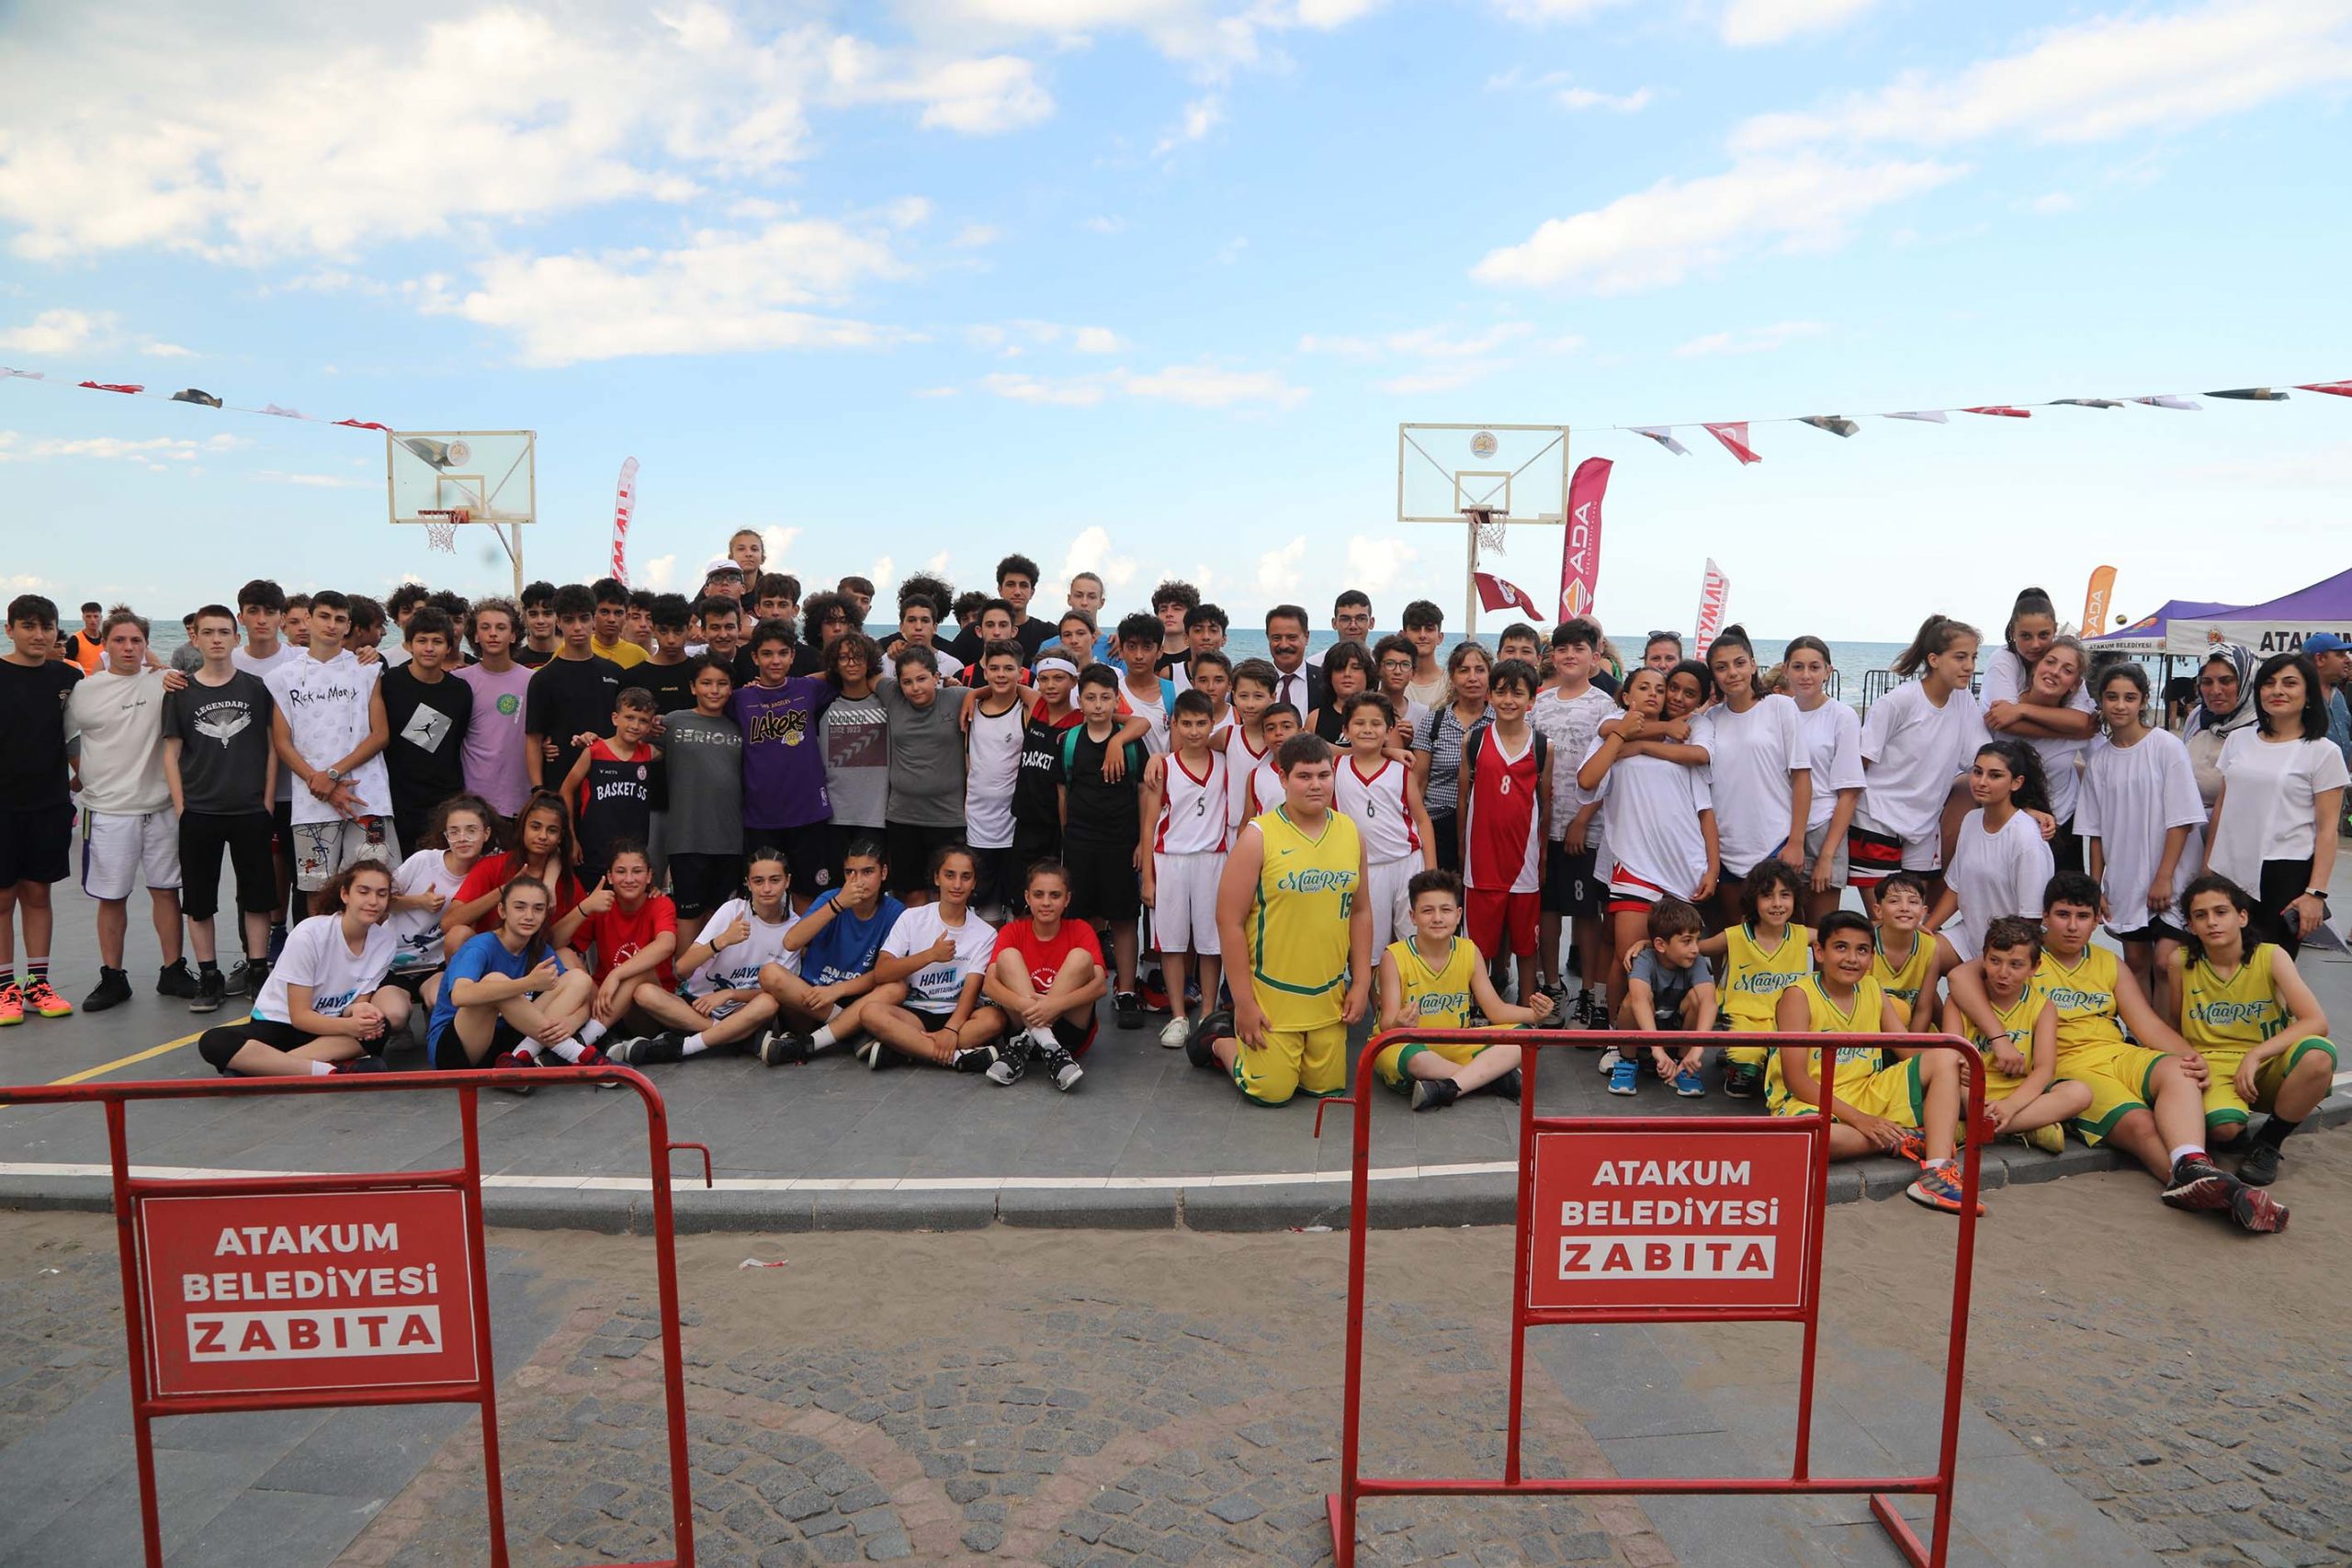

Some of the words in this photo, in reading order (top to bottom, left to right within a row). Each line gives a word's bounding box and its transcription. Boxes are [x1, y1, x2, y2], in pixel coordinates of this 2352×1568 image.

[1569, 501, 1591, 574] ADA
[2087, 590, 2103, 628] ADA
[194, 700, 251, 717] LEGENDARY
[596, 781, 637, 801] BASKET
[1500, 774, 1511, 795] 8
[1197, 796, 1205, 817] 5
[1367, 799, 1375, 818] 6
[1574, 879, 1584, 901] 8
[730, 966, 761, 979] HAYA
[920, 970, 956, 987] HAYAT
[1592, 1160, 1751, 1186] ATAKUM
[214, 1223, 399, 1257] ATAKUM
[1564, 1243, 1770, 1272] ZABITA
[193, 1314, 435, 1354] ZABITA
